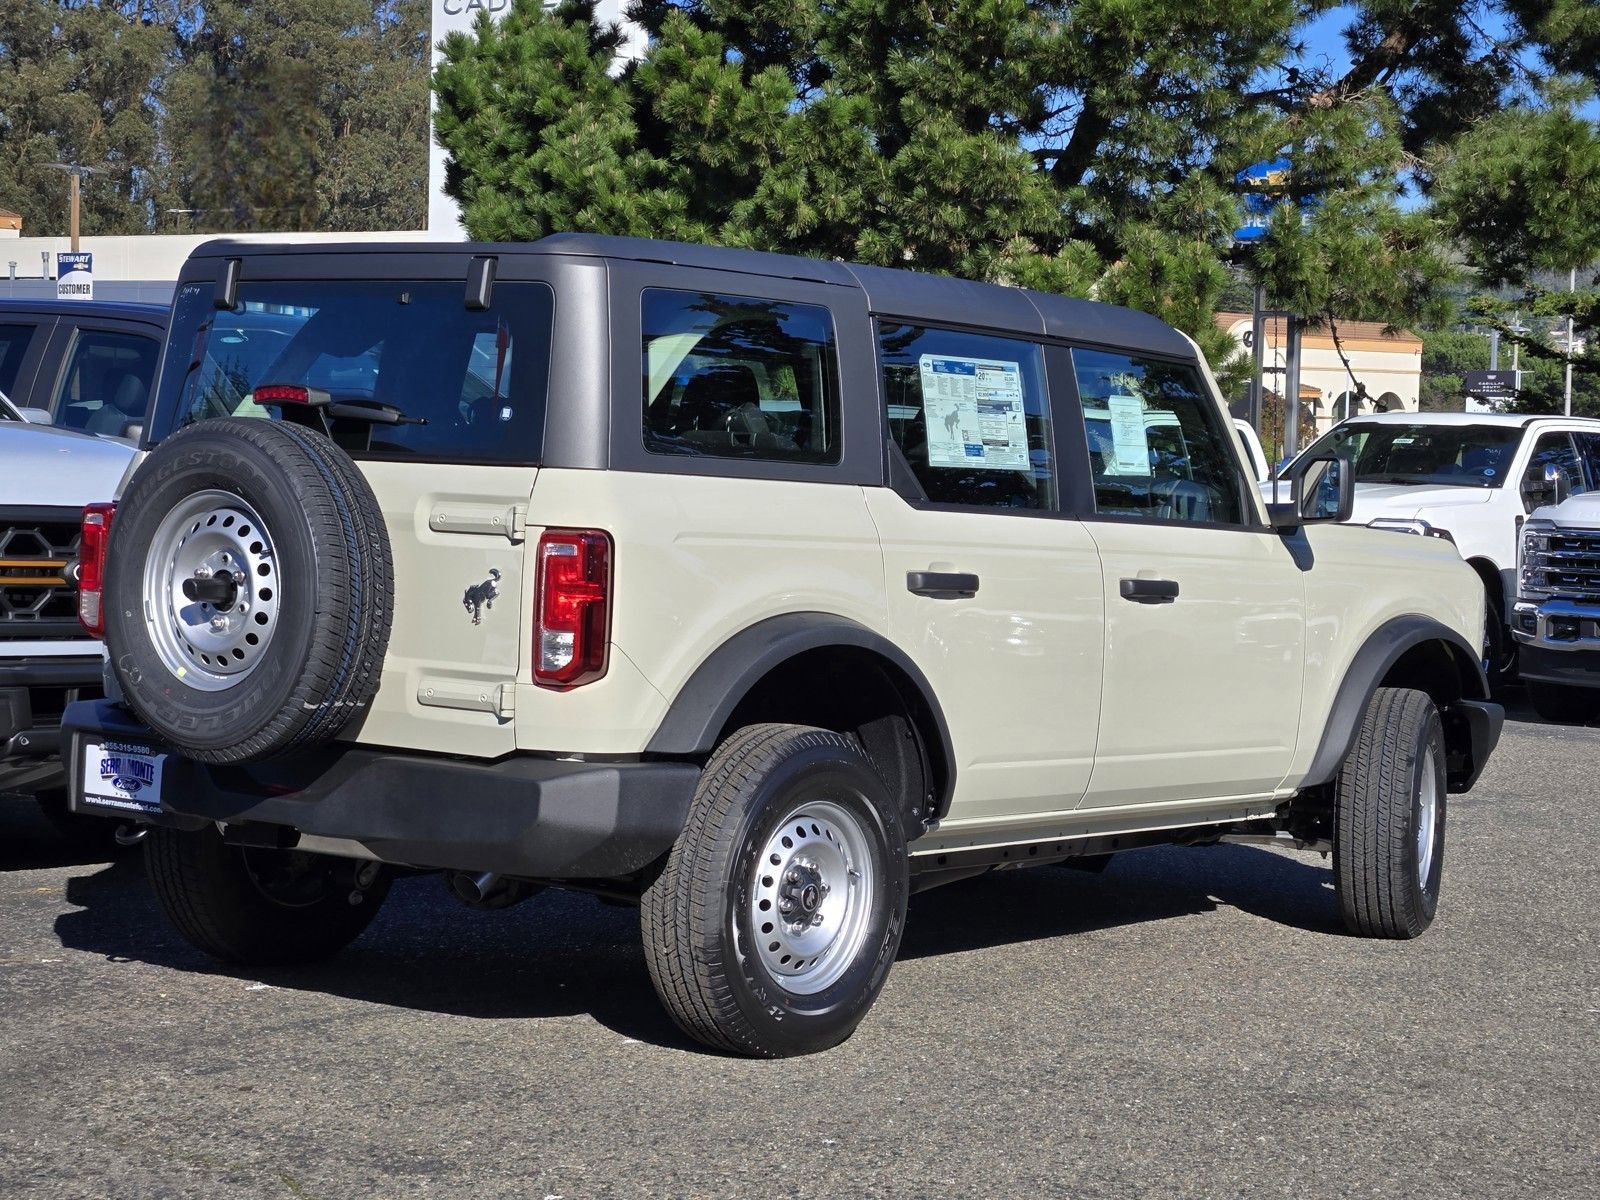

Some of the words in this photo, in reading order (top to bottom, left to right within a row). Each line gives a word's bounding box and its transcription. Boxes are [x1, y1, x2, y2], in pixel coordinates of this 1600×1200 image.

[58, 254, 91, 263] STEWART
[58, 283, 91, 295] CUSTOMER
[100, 757, 155, 781] SERRAMONTE
[116, 777, 138, 790] Ford
